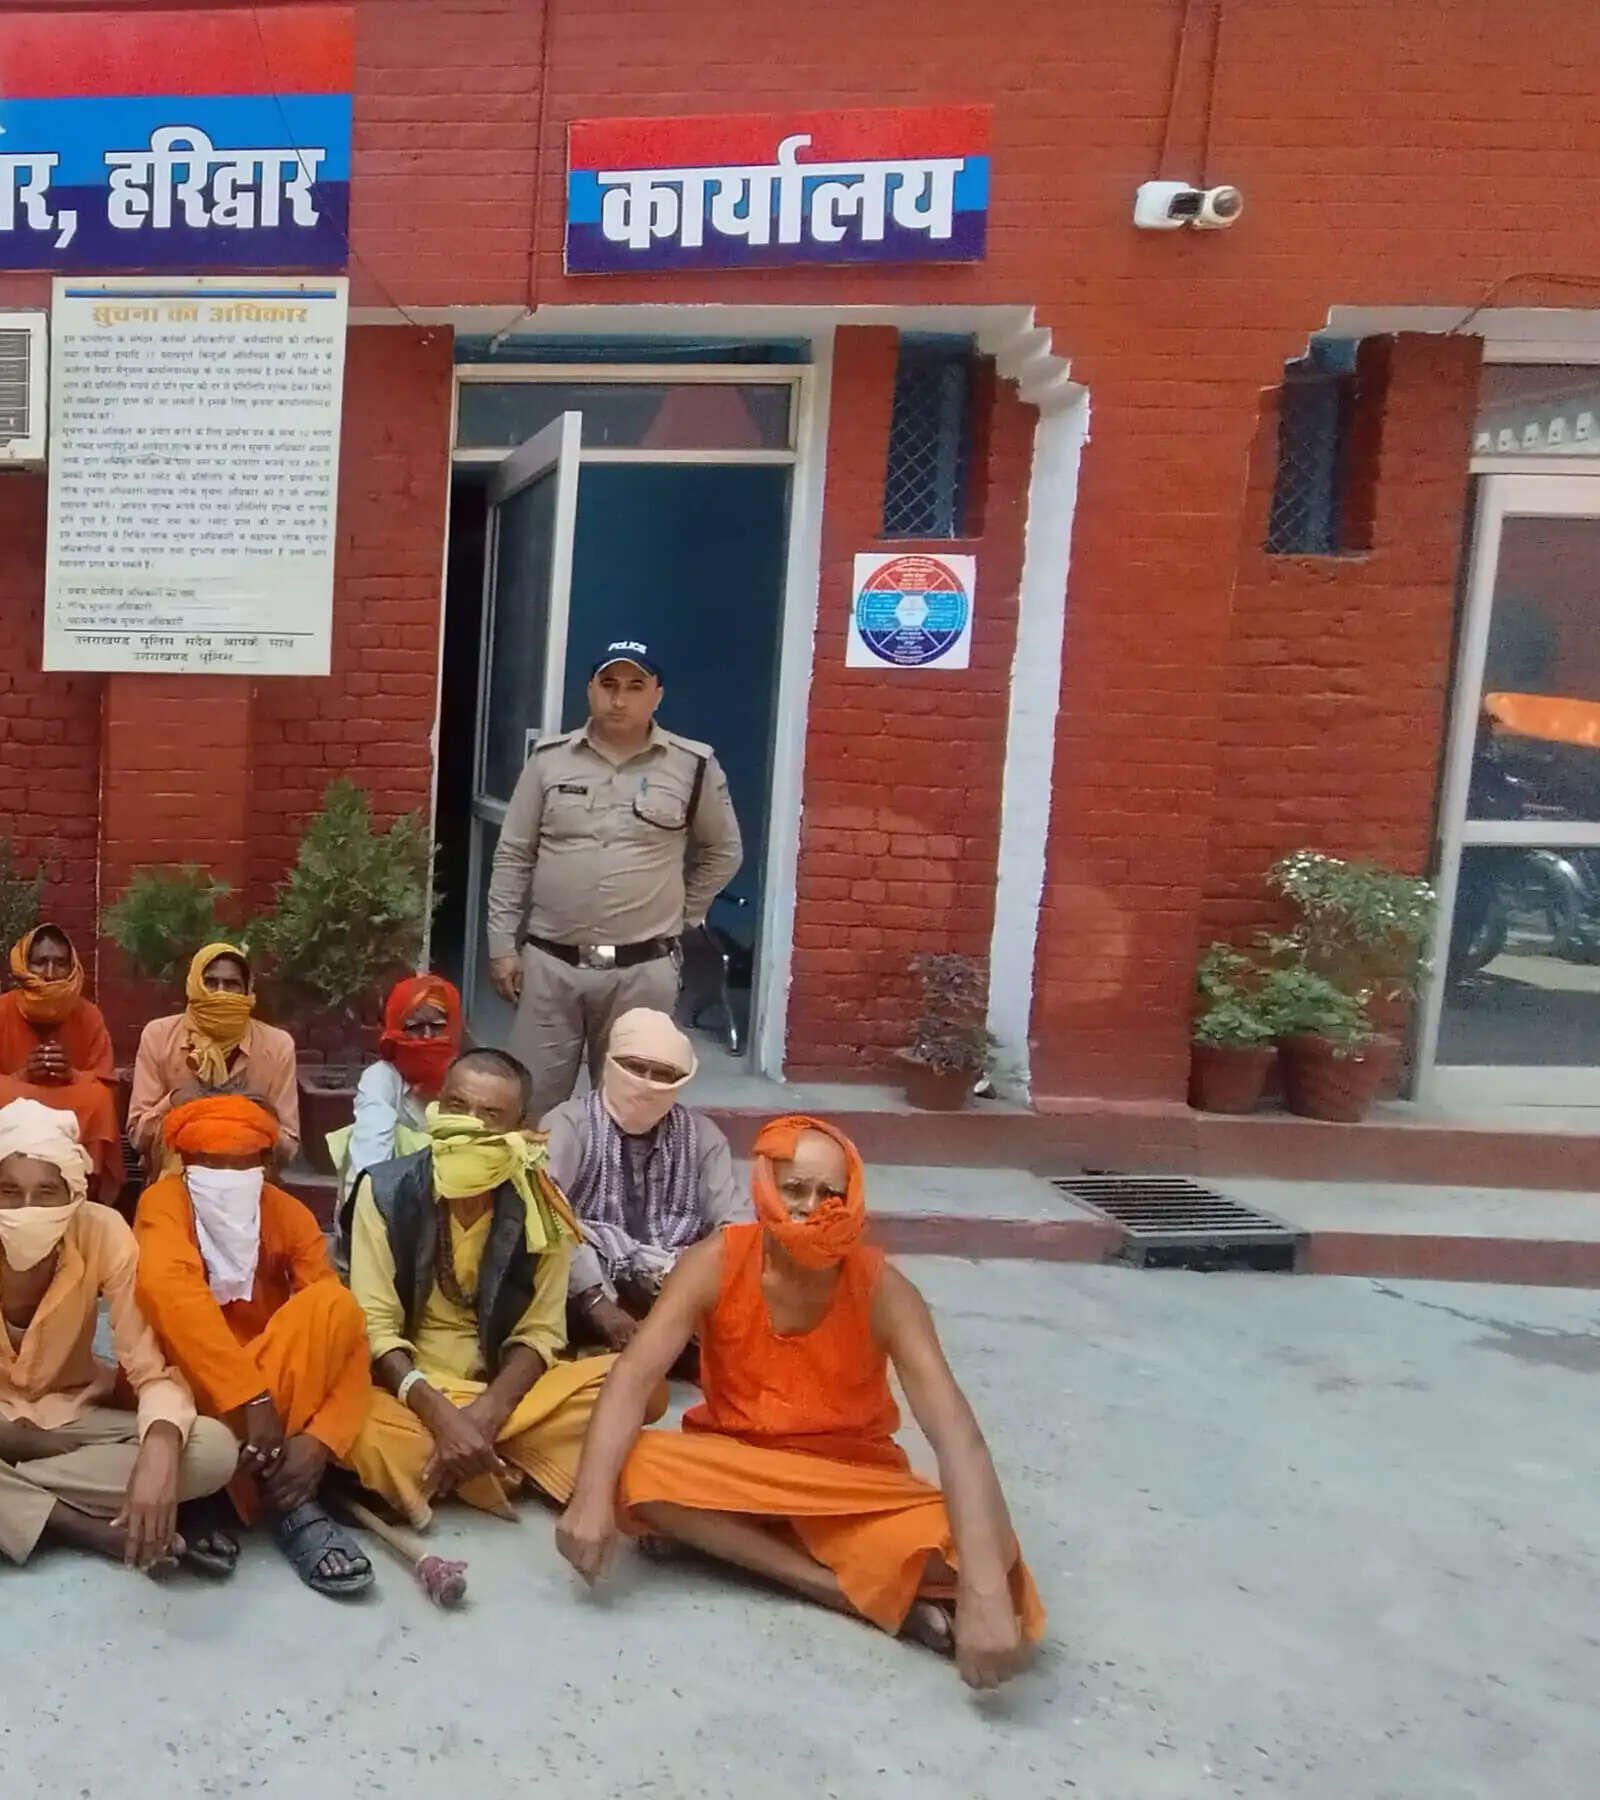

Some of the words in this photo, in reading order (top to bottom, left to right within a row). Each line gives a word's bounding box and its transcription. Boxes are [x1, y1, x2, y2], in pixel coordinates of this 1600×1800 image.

[104, 126, 326, 231] हरिद्वार
[598, 134, 964, 248] कार्यालय
[93, 303, 158, 328] सूचना
[168, 305, 198, 323] का
[209, 302, 308, 324] अधिकार
[608, 641, 648, 654] POLICE
